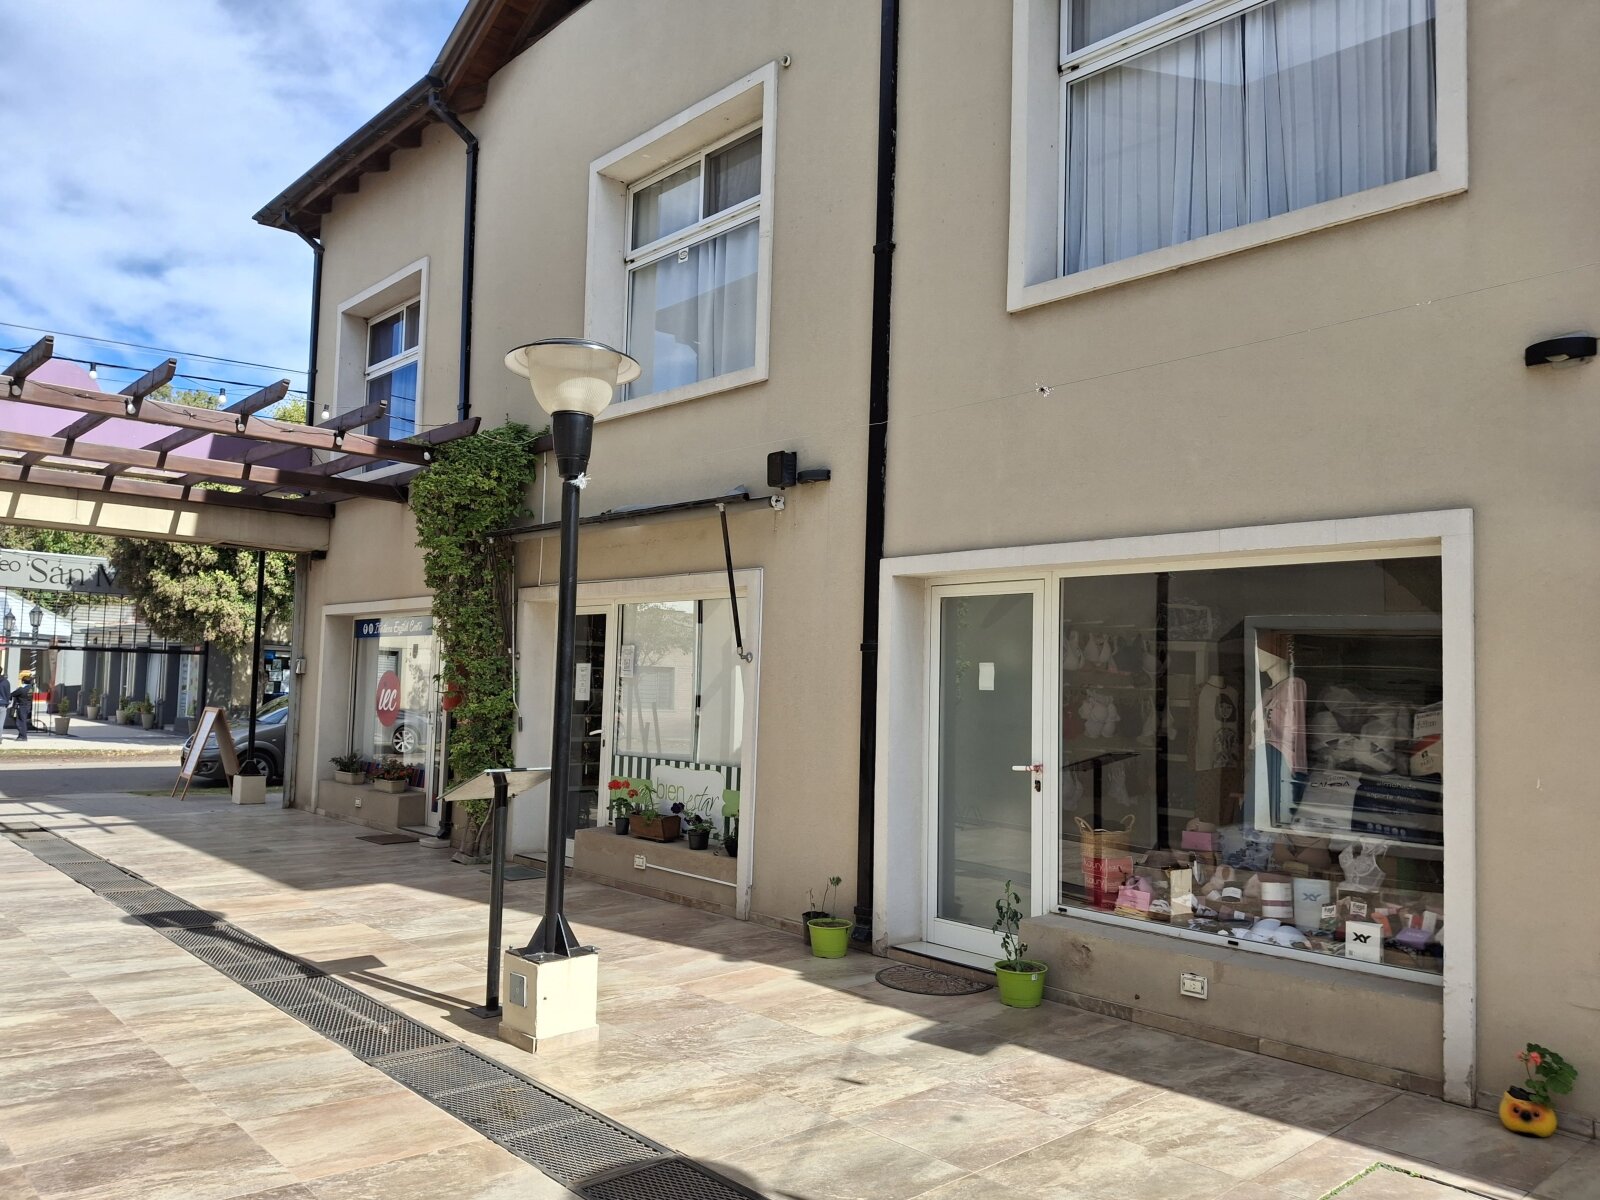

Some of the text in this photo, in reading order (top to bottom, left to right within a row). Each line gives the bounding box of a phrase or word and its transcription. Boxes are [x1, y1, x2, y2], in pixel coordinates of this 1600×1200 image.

[29, 557, 85, 586] San
[1302, 892, 1322, 902] XY
[1352, 931, 1372, 944] XY
